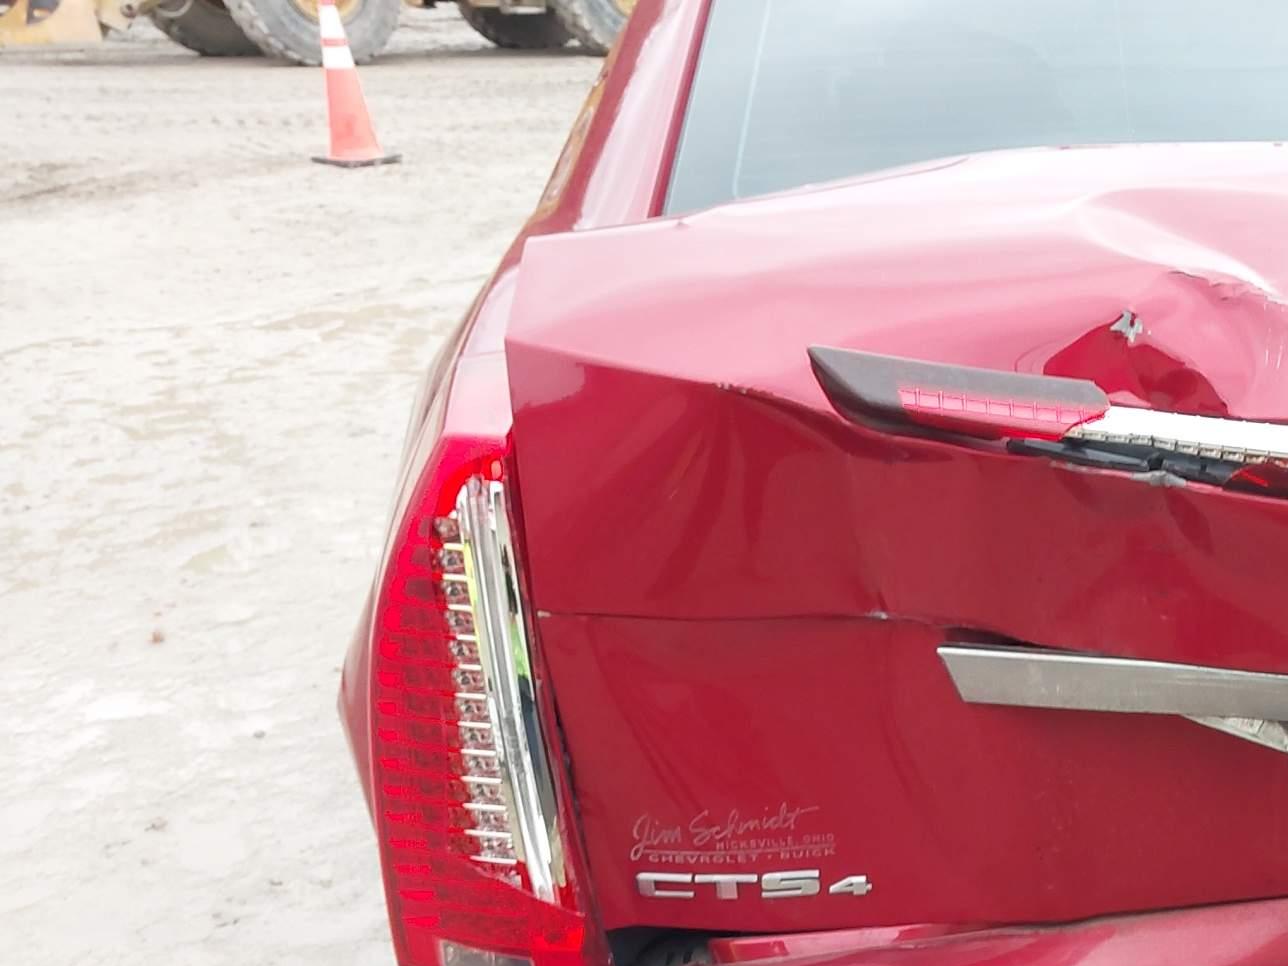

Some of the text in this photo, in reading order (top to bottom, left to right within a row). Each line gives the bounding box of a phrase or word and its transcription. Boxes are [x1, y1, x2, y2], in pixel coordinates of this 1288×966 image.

[630, 802, 819, 861] Jim Schmidt
[802, 832, 835, 843] OHIO
[649, 848, 836, 864] CHEVROLET BUICK
[636, 869, 873, 900] CTS 4
